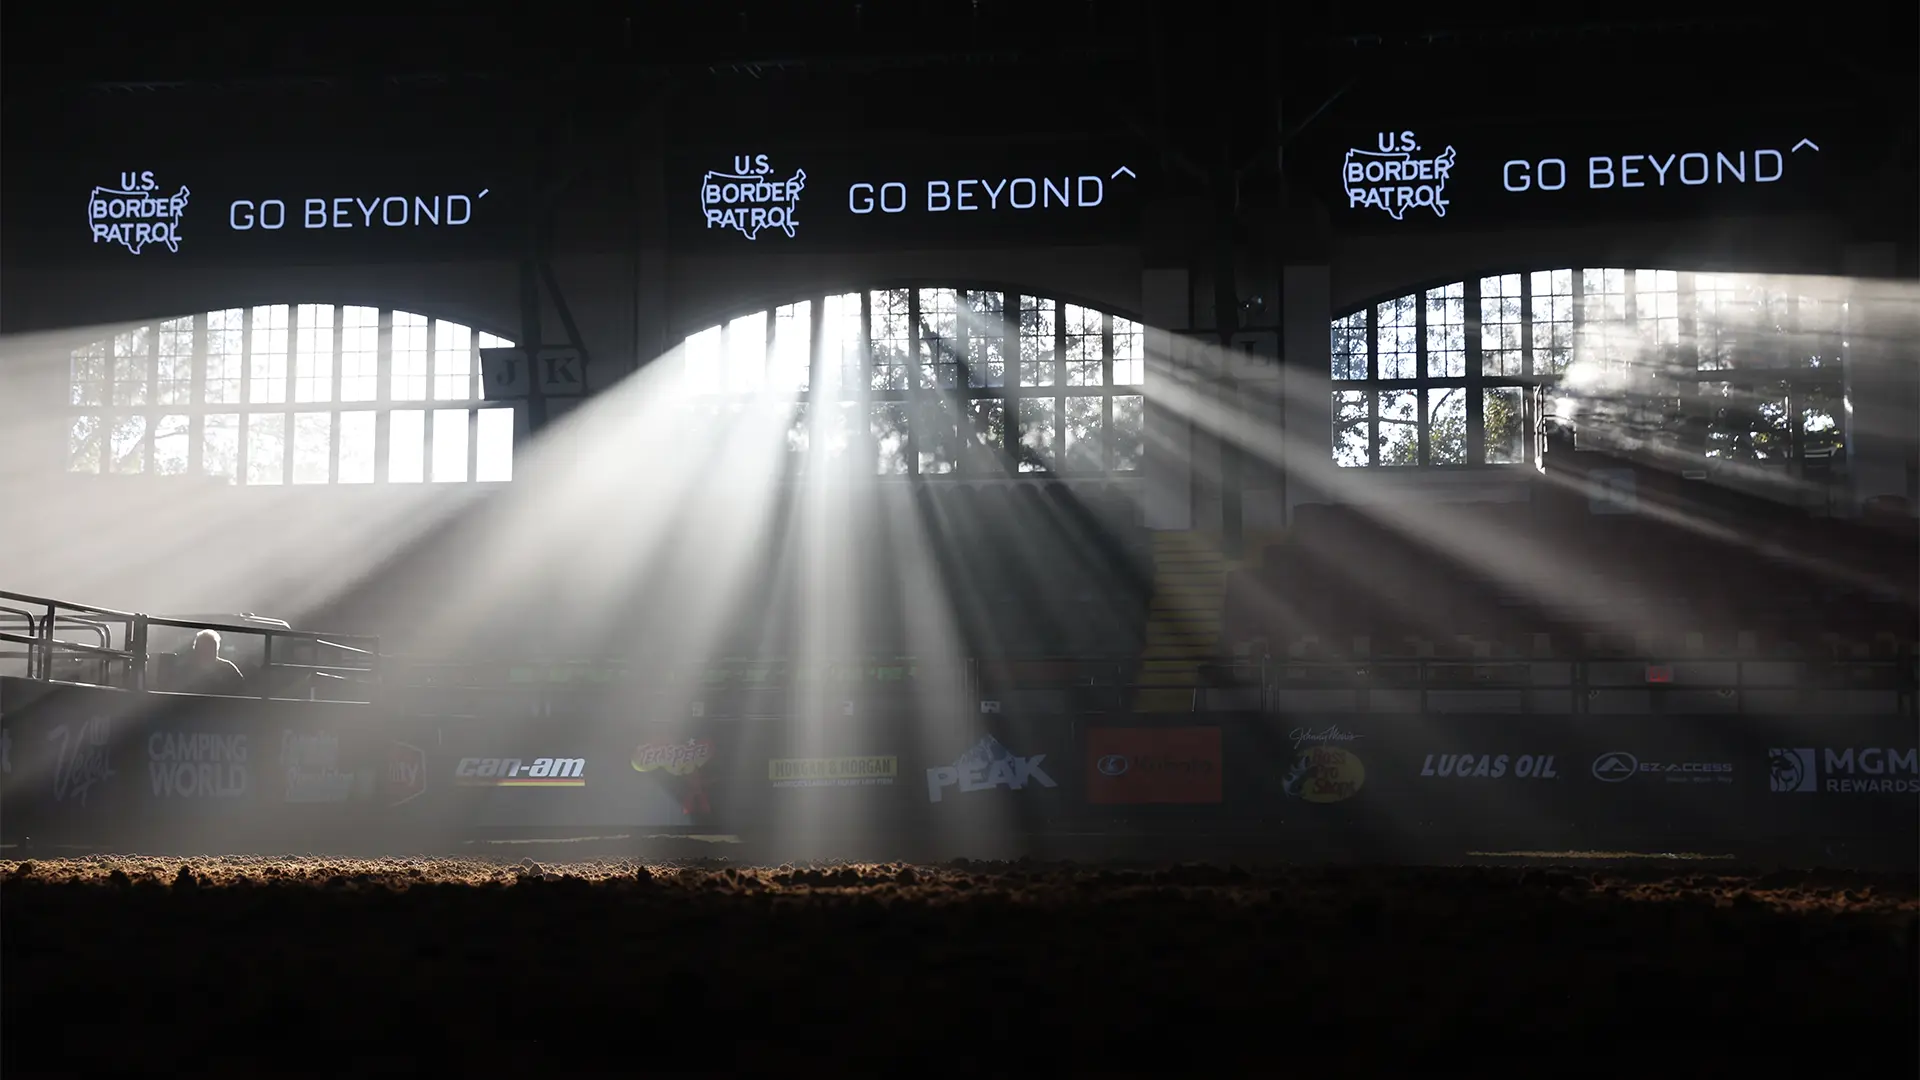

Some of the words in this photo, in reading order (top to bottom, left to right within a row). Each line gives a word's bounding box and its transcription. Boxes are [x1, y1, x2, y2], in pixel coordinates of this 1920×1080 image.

[1378, 130, 1421, 153] U.S.
[734, 154, 774, 175] U.S.
[1347, 158, 1450, 182] BORDER
[1503, 158, 1566, 192] GO
[1588, 149, 1783, 189] BEYOND
[121, 171, 159, 191] U.S.
[705, 181, 801, 204] BORDER
[848, 182, 906, 214] GO
[926, 176, 1103, 211] BEYOND
[1349, 184, 1450, 209] PATROL
[92, 197, 185, 220] BORDER
[230, 200, 285, 230] GO
[304, 194, 471, 228] BEYOND
[707, 205, 799, 229] PATROL
[93, 221, 182, 243] PATROL
[496, 359, 521, 386] J
[543, 357, 580, 385] K
[148, 729, 248, 762] CAMPING
[455, 757, 586, 778] can-am
[775, 761, 825, 778] MORGAN
[828, 760, 837, 775] &
[840, 758, 891, 775] MORGAN
[1420, 753, 1509, 778] LUCAS
[1514, 753, 1557, 778] OIL
[1639, 762, 1733, 773] EZ-ACCESS
[1824, 747, 1919, 775] MGM
[148, 761, 248, 799] WORLD
[926, 753, 1059, 804] PEAK
[1826, 778, 1920, 793] REWARDS
